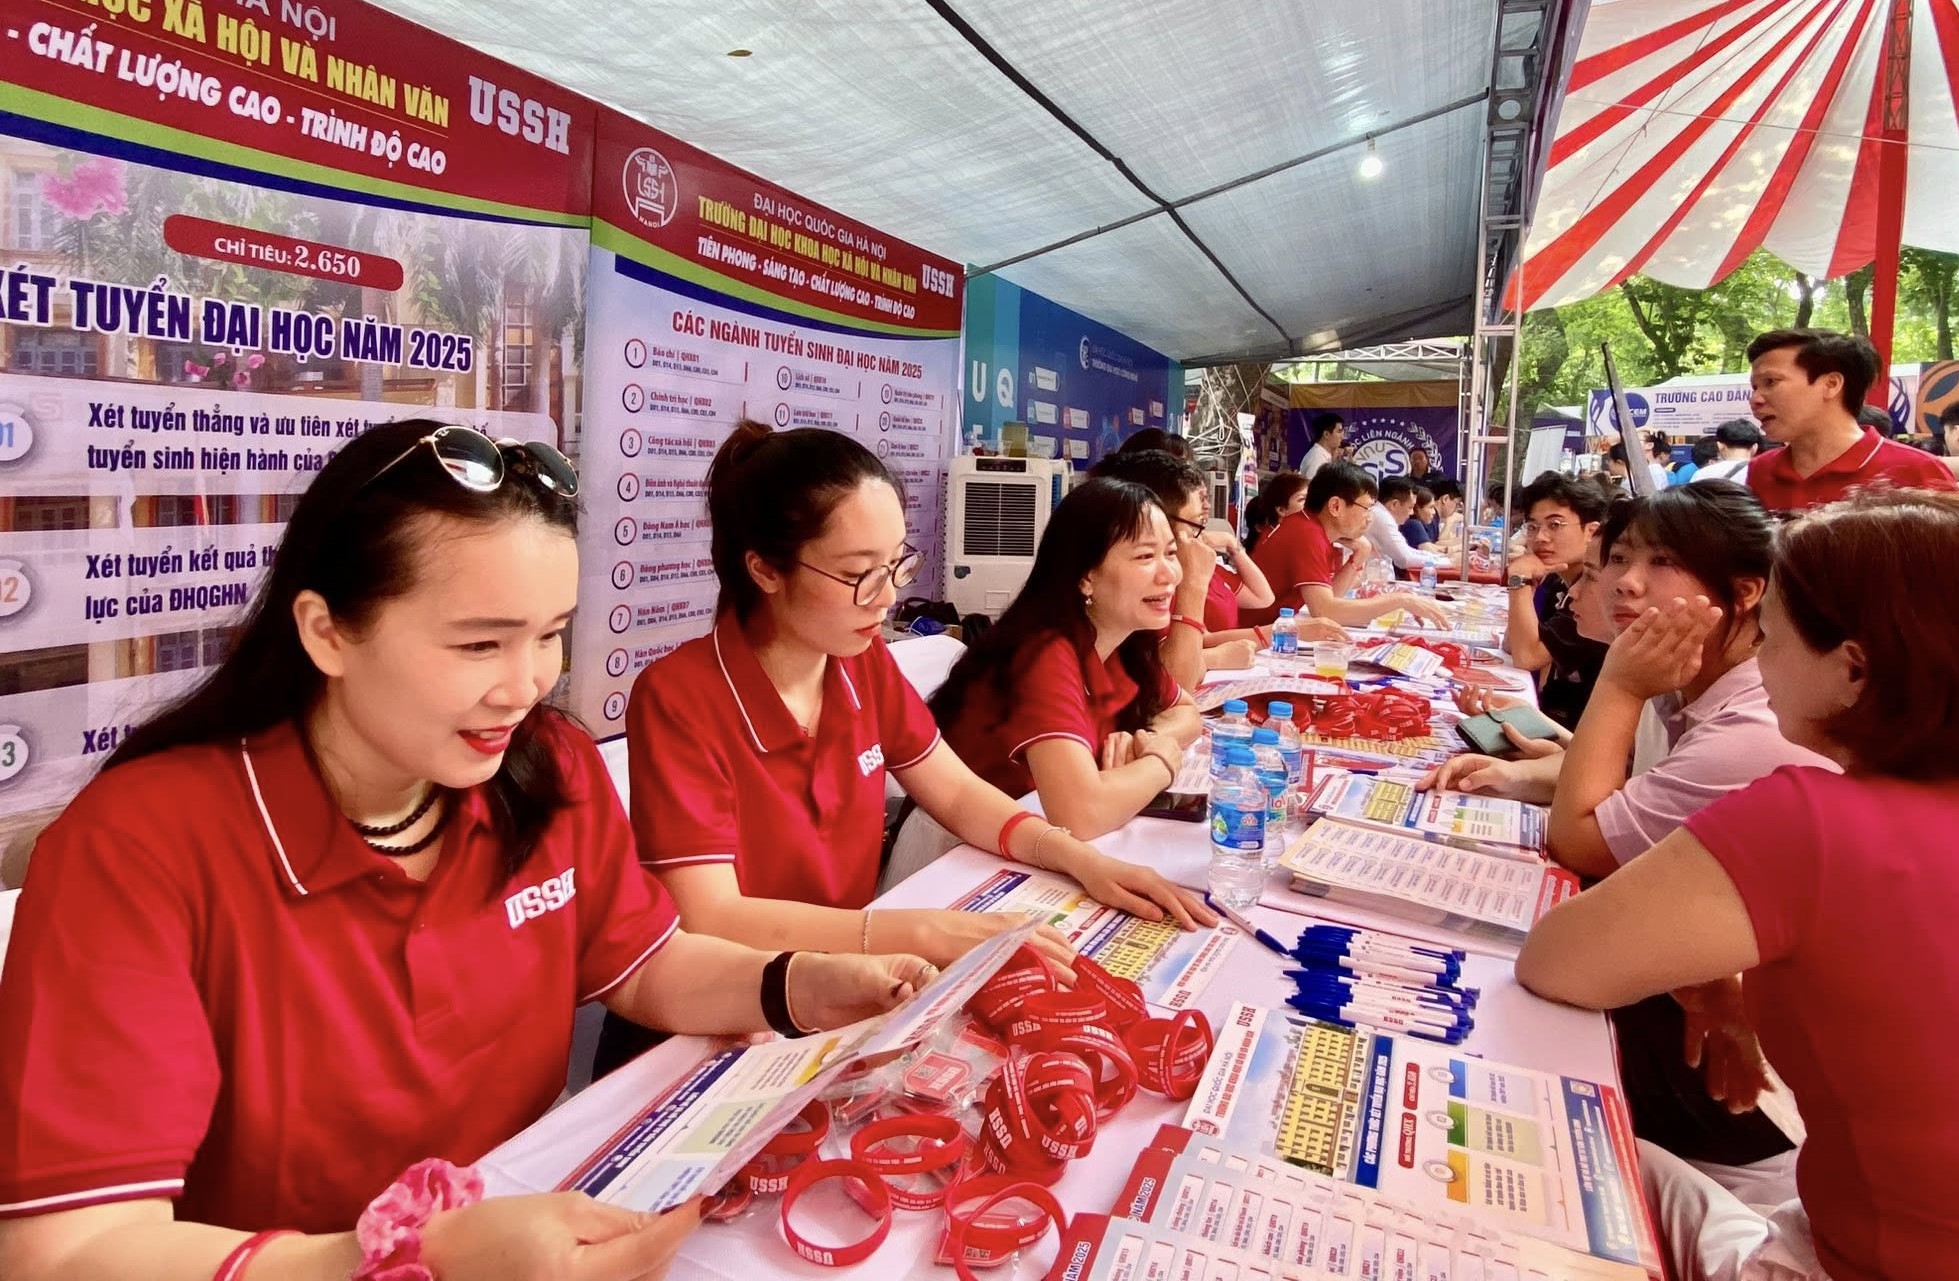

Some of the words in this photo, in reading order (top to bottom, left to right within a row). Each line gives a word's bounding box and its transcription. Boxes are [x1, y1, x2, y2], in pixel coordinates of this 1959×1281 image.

[281, 0, 336, 41] NỘI
[217, 13, 271, 66] HỘI
[280, 37, 319, 83] VÀ
[327, 56, 396, 109] NHÂN
[404, 83, 450, 128] VĂN
[28, 22, 114, 73] CHẤT
[118, 49, 222, 107] LƯỢNG
[228, 85, 281, 124] CAO
[300, 107, 367, 152] TRÌNH
[371, 130, 402, 168] ĐỘ
[407, 144, 446, 175] CAO
[469, 75, 571, 155] USSH
[698, 195, 746, 234] TRƯỜNG
[749, 215, 768, 243] ĐẠI
[770, 223, 791, 250] HỌC
[794, 233, 820, 260] KHOA
[821, 243, 840, 269] HỌC
[842, 250, 853, 272] XÃ
[754, 193, 775, 216] ĐẠI
[778, 203, 802, 226] HỌC
[805, 215, 835, 239] QUỐC
[837, 229, 854, 247] GIA
[856, 235, 869, 253] HÀ
[871, 242, 886, 261] NỘI
[214, 237, 245, 255] CHỈ
[248, 244, 292, 265] TIÊU:
[294, 246, 361, 277] 2.650
[698, 235, 720, 260] TIÊN
[721, 245, 757, 271] PHONG
[763, 257, 787, 280] SÁNG
[789, 267, 805, 289] TẠO
[810, 270, 829, 294] CHẤT
[830, 280, 855, 302] LƯỢNG
[856, 289, 870, 305] CAO
[903, 304, 915, 319] CAO
[922, 263, 955, 298] USSH
[70, 277, 190, 340] TUYỂN
[202, 300, 260, 354] ĐẠI
[272, 311, 333, 360] HỌC
[343, 317, 401, 363] NĂM
[410, 330, 471, 371] 2025
[672, 310, 705, 336] CÁC
[710, 319, 760, 348] NGÀNH
[764, 329, 803, 356] TUYỂN
[807, 341, 834, 363] SINH
[837, 348, 854, 369] ĐẠI
[857, 353, 876, 373] HỌC
[879, 355, 900, 375] NĂM
[901, 362, 922, 379] 2025
[631, 392, 636, 405] 2
[972, 360, 987, 402] U
[1701, 391, 1723, 402] CAO
[88, 402, 125, 428] Xét
[131, 401, 187, 433] tuyển
[192, 403, 244, 436] thẳng
[250, 412, 270, 434] và
[275, 415, 295, 435] ưu
[301, 416, 331, 437] tiên
[336, 418, 359, 438] xét
[88, 440, 146, 472] tuyển
[153, 447, 194, 470] sinh
[201, 447, 241, 475] hiện
[246, 449, 288, 470] hành
[294, 447, 322, 471] của
[625, 481, 631, 493] 4
[623, 525, 628, 537] 5
[85, 552, 121, 579] Xét
[128, 545, 182, 577] tuyển
[189, 545, 218, 572] kết
[224, 543, 256, 571] quả
[620, 569, 625, 581] 6
[0, 576, 18, 603] 2
[85, 595, 118, 624] lực
[126, 588, 162, 616] của
[170, 583, 247, 612] ĐHQGHN
[617, 613, 623, 625] 7
[615, 656, 620, 668] 8
[611, 700, 617, 713] 9
[82, 726, 118, 755] Xét
[857, 742, 885, 777] USS
[504, 866, 576, 929] USSH
[1237, 1005, 1256, 1027] USSH
[1041, 1134, 1079, 1158] USSH
[750, 1175, 789, 1193] USSH
[1141, 1177, 1155, 1200] 2025
[796, 1241, 834, 1265] USSH
[1073, 1241, 1090, 1266] 2025
